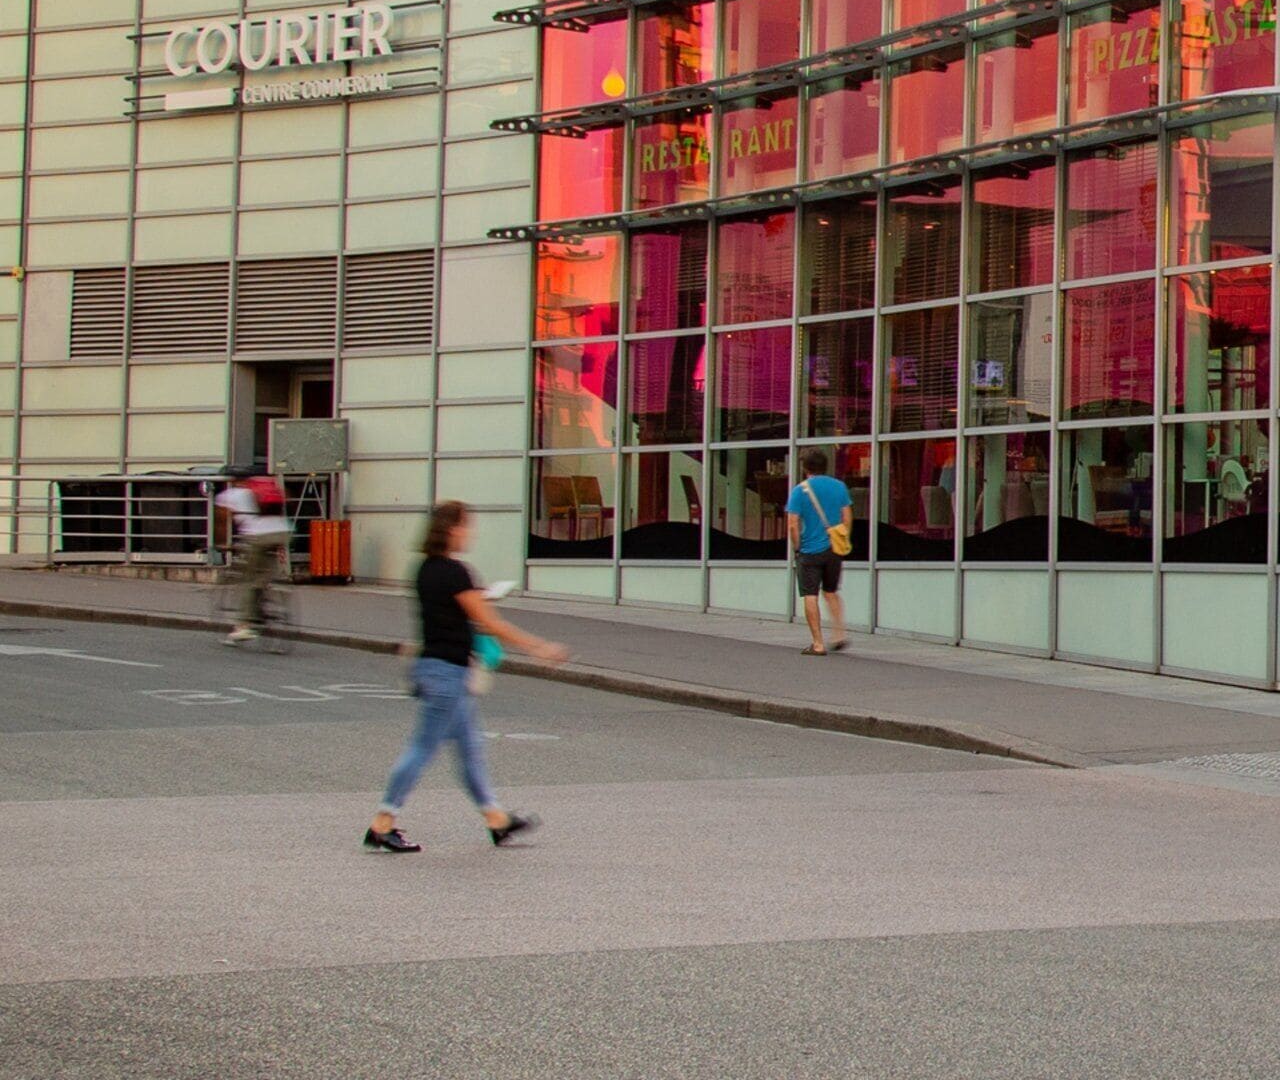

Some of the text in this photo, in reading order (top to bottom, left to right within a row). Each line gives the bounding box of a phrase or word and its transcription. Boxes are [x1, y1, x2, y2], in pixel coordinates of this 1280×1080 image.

[165, 4, 394, 77] COURIER
[242, 73, 392, 104] CENTRE COMMERCIAL
[642, 119, 795, 172] RESTARANT
